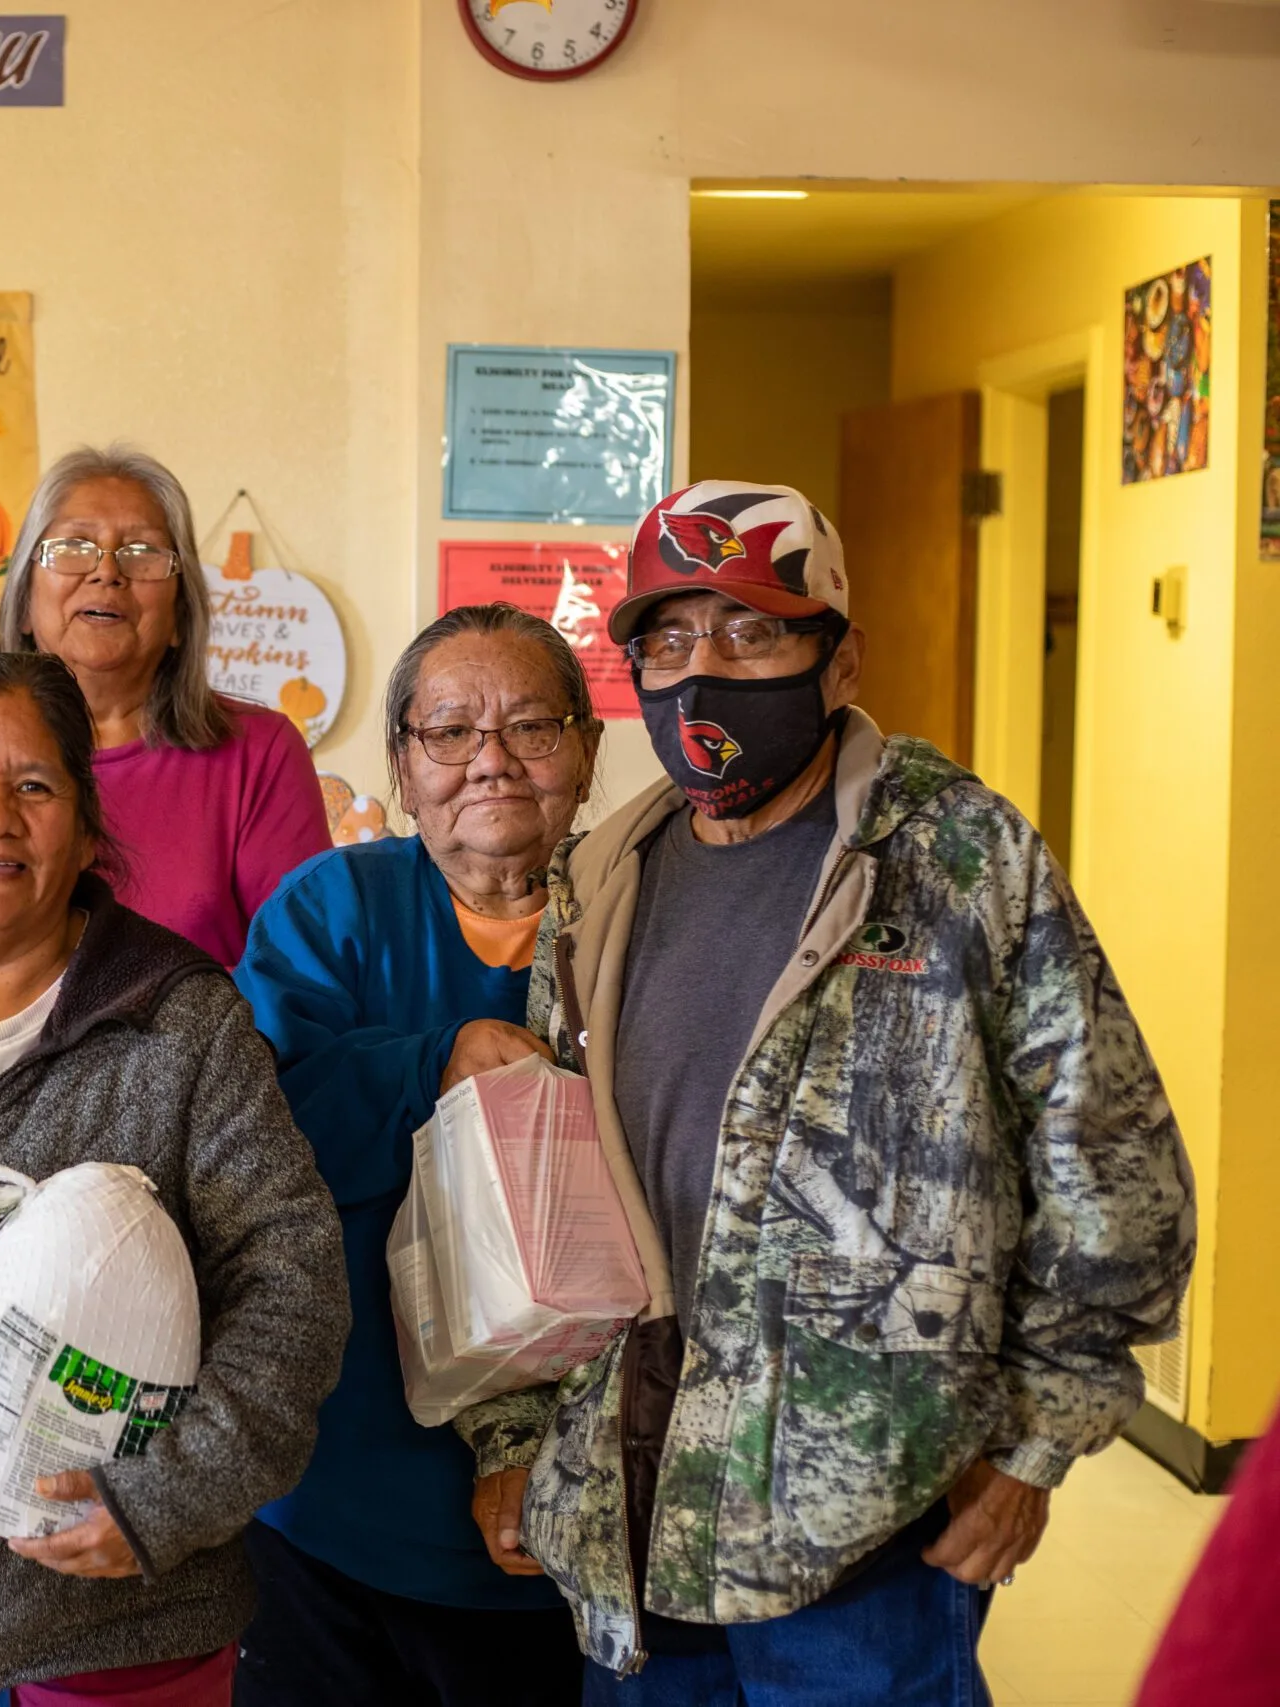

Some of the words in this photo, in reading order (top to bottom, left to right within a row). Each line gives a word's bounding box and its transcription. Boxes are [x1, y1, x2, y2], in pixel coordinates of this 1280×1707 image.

[503, 28, 516, 46] 7
[531, 41, 544, 61] 6
[563, 39, 577, 59] 5
[888, 958, 927, 974] OAK
